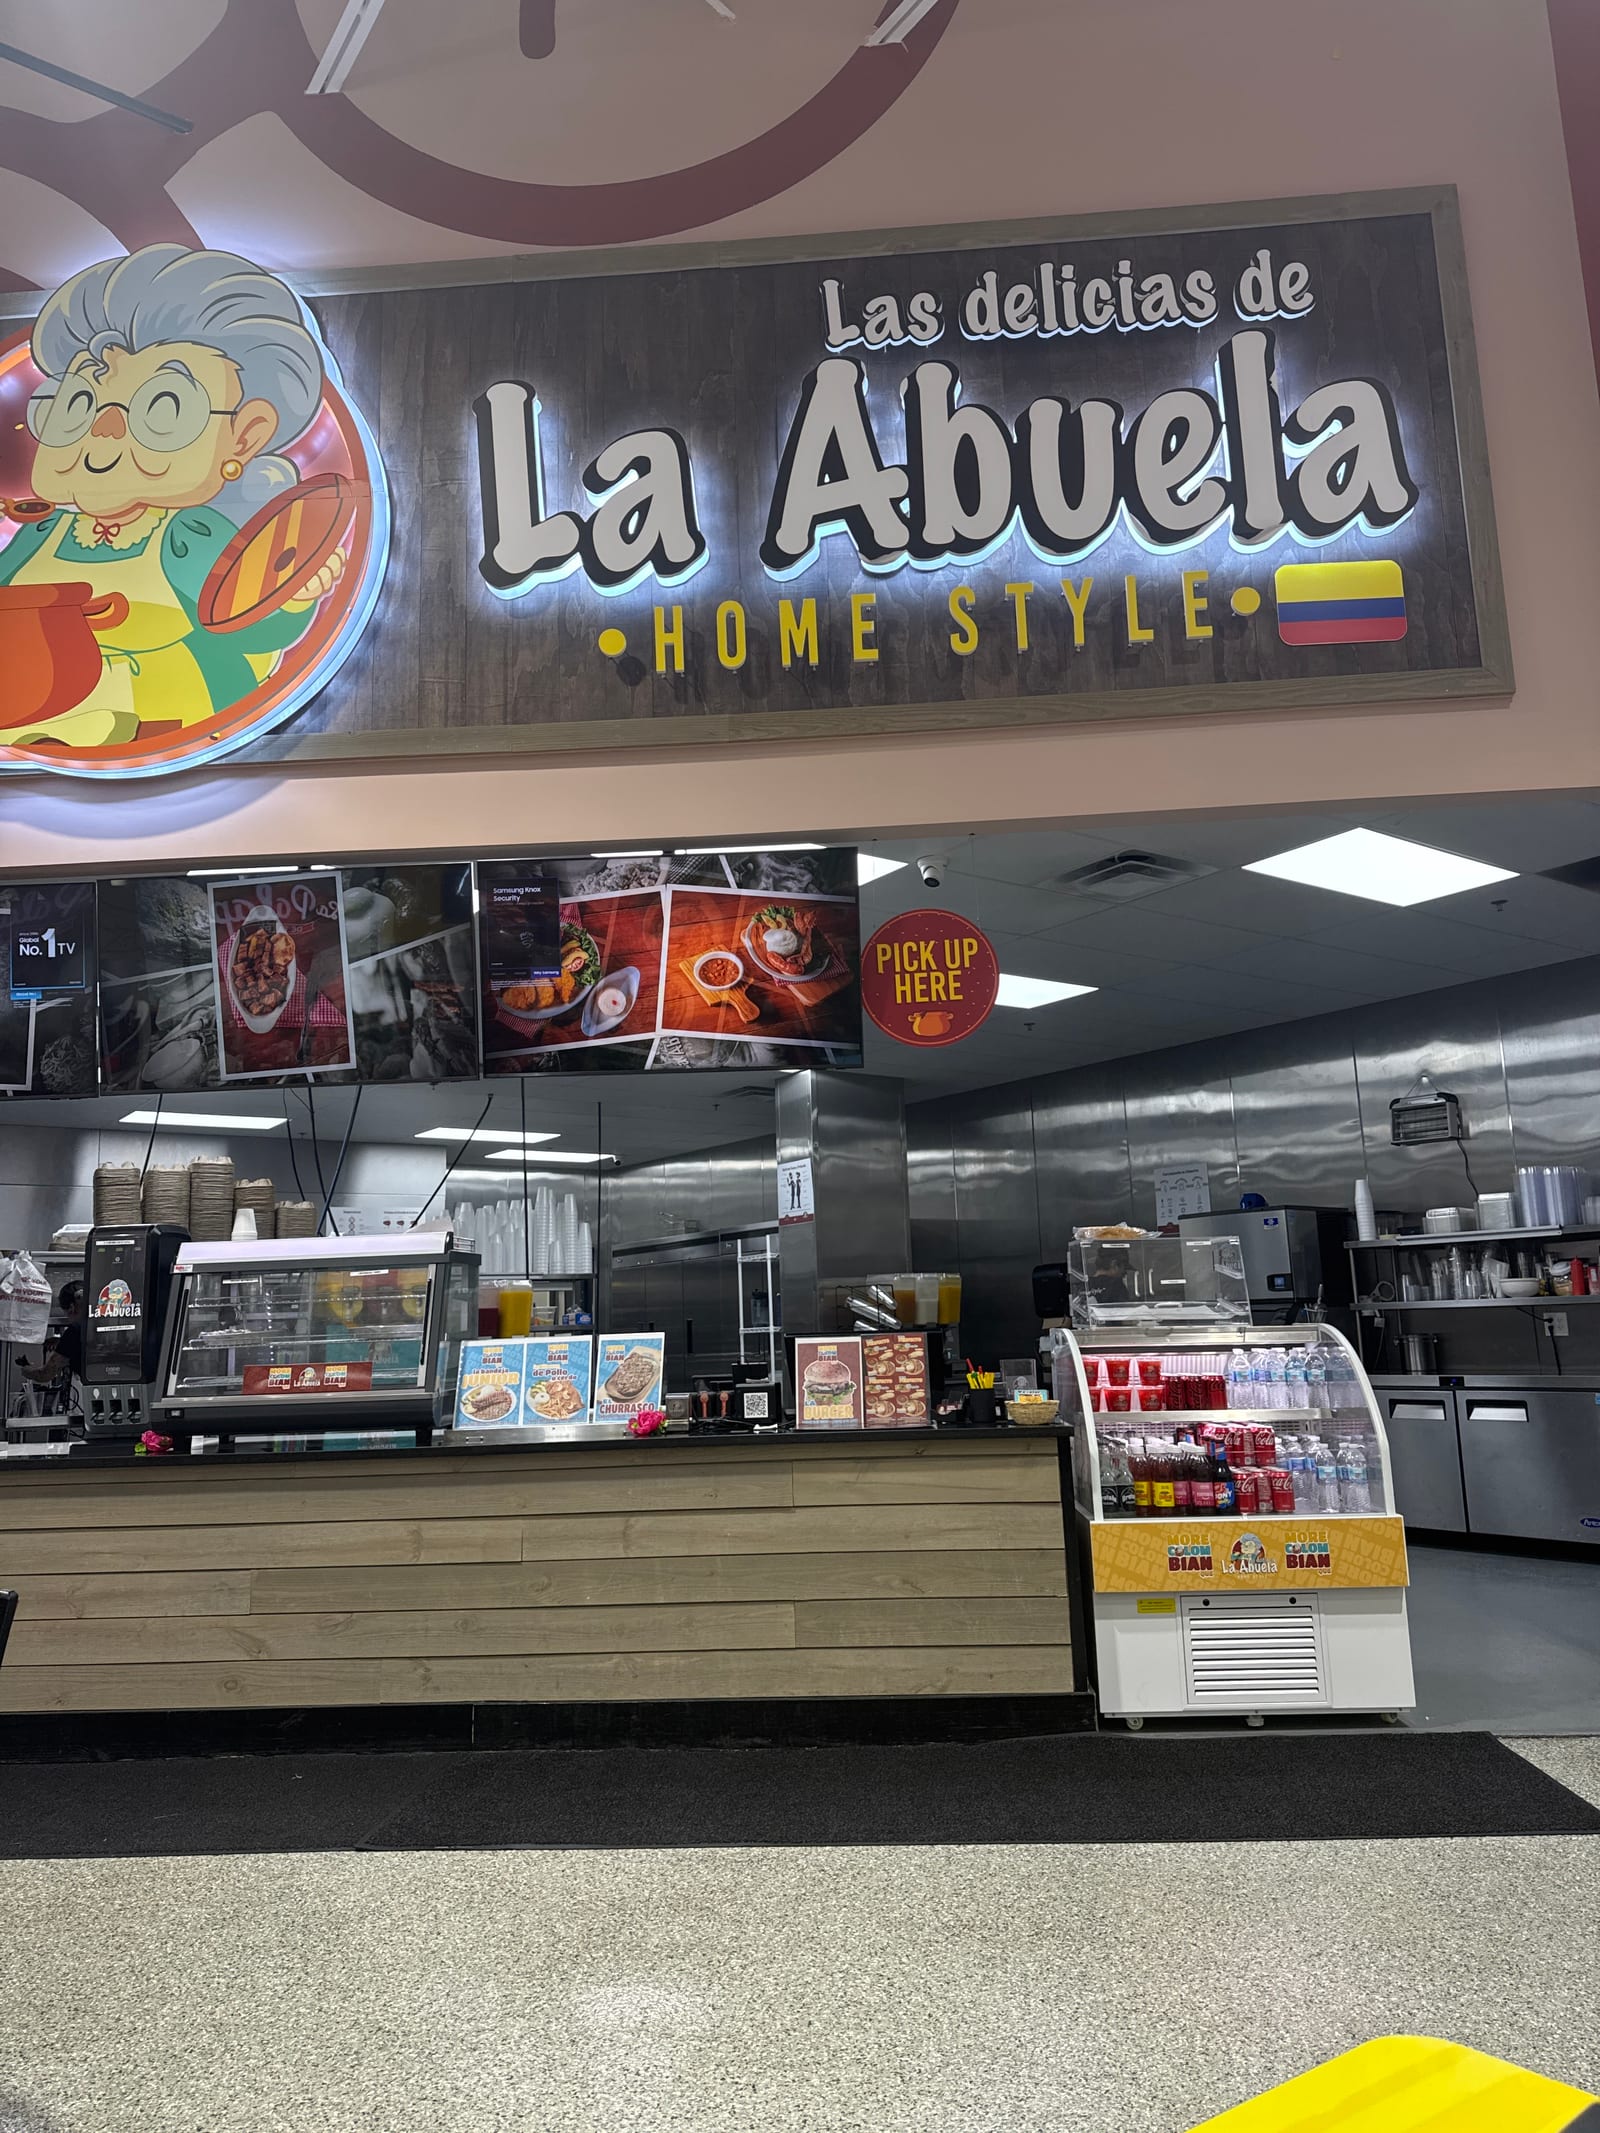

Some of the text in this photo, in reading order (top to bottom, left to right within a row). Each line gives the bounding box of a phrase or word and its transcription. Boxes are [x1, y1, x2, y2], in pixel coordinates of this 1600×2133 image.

[819, 249, 1314, 351] Las delicias de
[476, 330, 1418, 592] La Abuela
[653, 570, 1215, 675] HOME STYLE
[57, 942, 76, 955] TV
[876, 938, 978, 974] PICK UP
[895, 970, 963, 1004] HERE
[88, 1303, 141, 1318] La Abuela
[545, 1368, 568, 1376] Pollo
[462, 1372, 519, 1388] JUNIOR
[600, 1403, 655, 1414] CHURRASCO
[805, 1406, 853, 1419] BURGER
[1168, 1534, 1210, 1546] MORE
[1284, 1531, 1328, 1543] MORE
[1168, 1557, 1213, 1572] BIAN
[1222, 1558, 1278, 1574] La Abuela
[1286, 1554, 1331, 1569] BIAN
